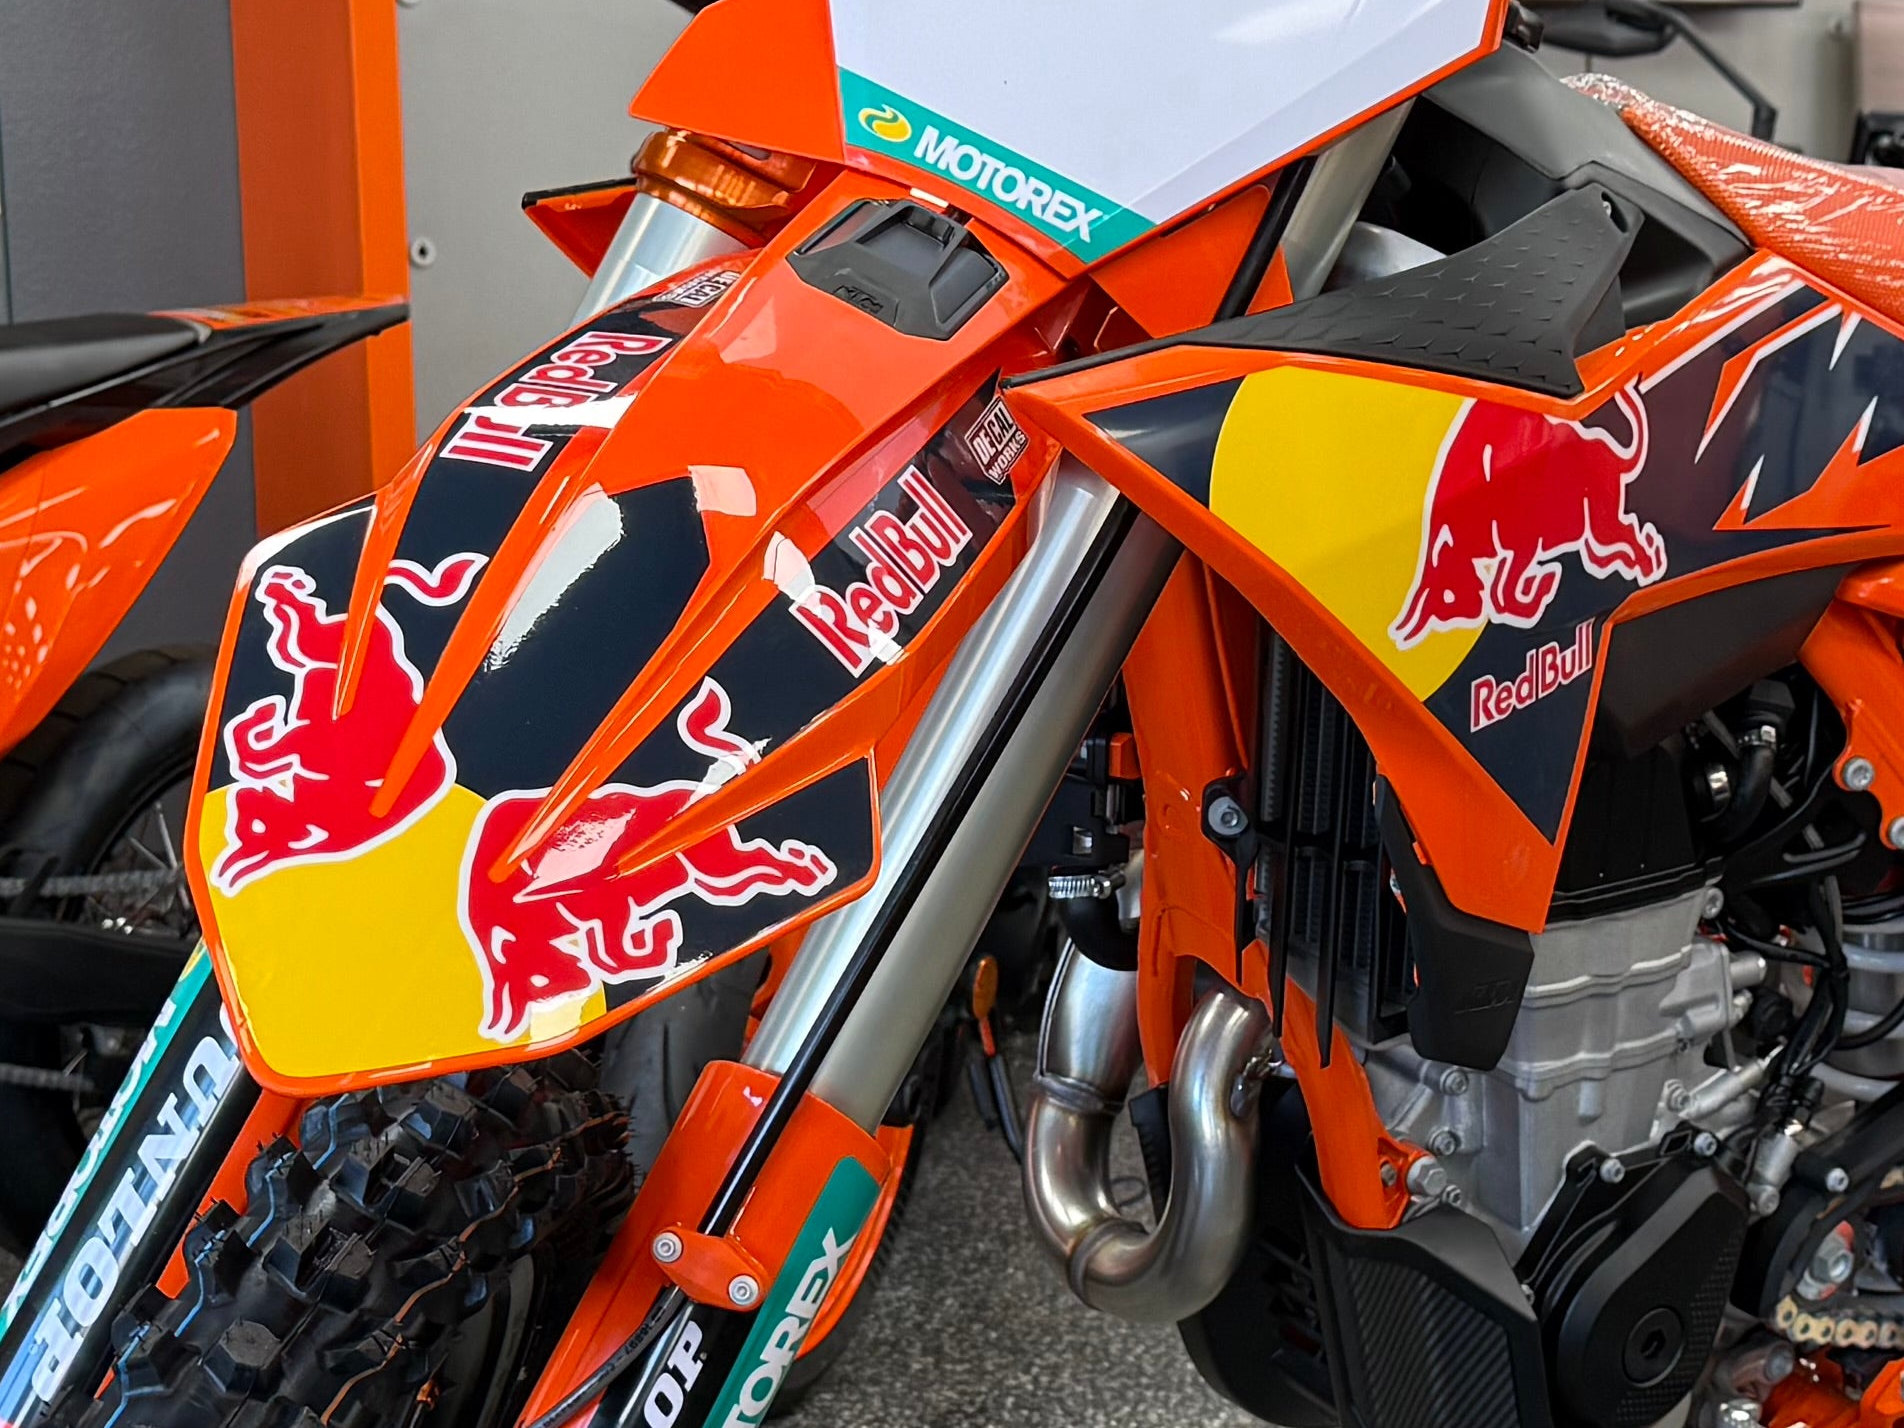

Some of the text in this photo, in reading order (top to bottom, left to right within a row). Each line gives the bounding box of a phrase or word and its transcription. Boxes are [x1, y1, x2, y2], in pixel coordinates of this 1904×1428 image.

[913, 124, 1103, 243] MOTOREX
[520, 332, 672, 393] Red
[988, 430, 1026, 479] WORKS
[789, 465, 973, 678] Red Bull
[1470, 617, 1595, 733] Red Bull
[32, 1002, 243, 1403] UNLOP
